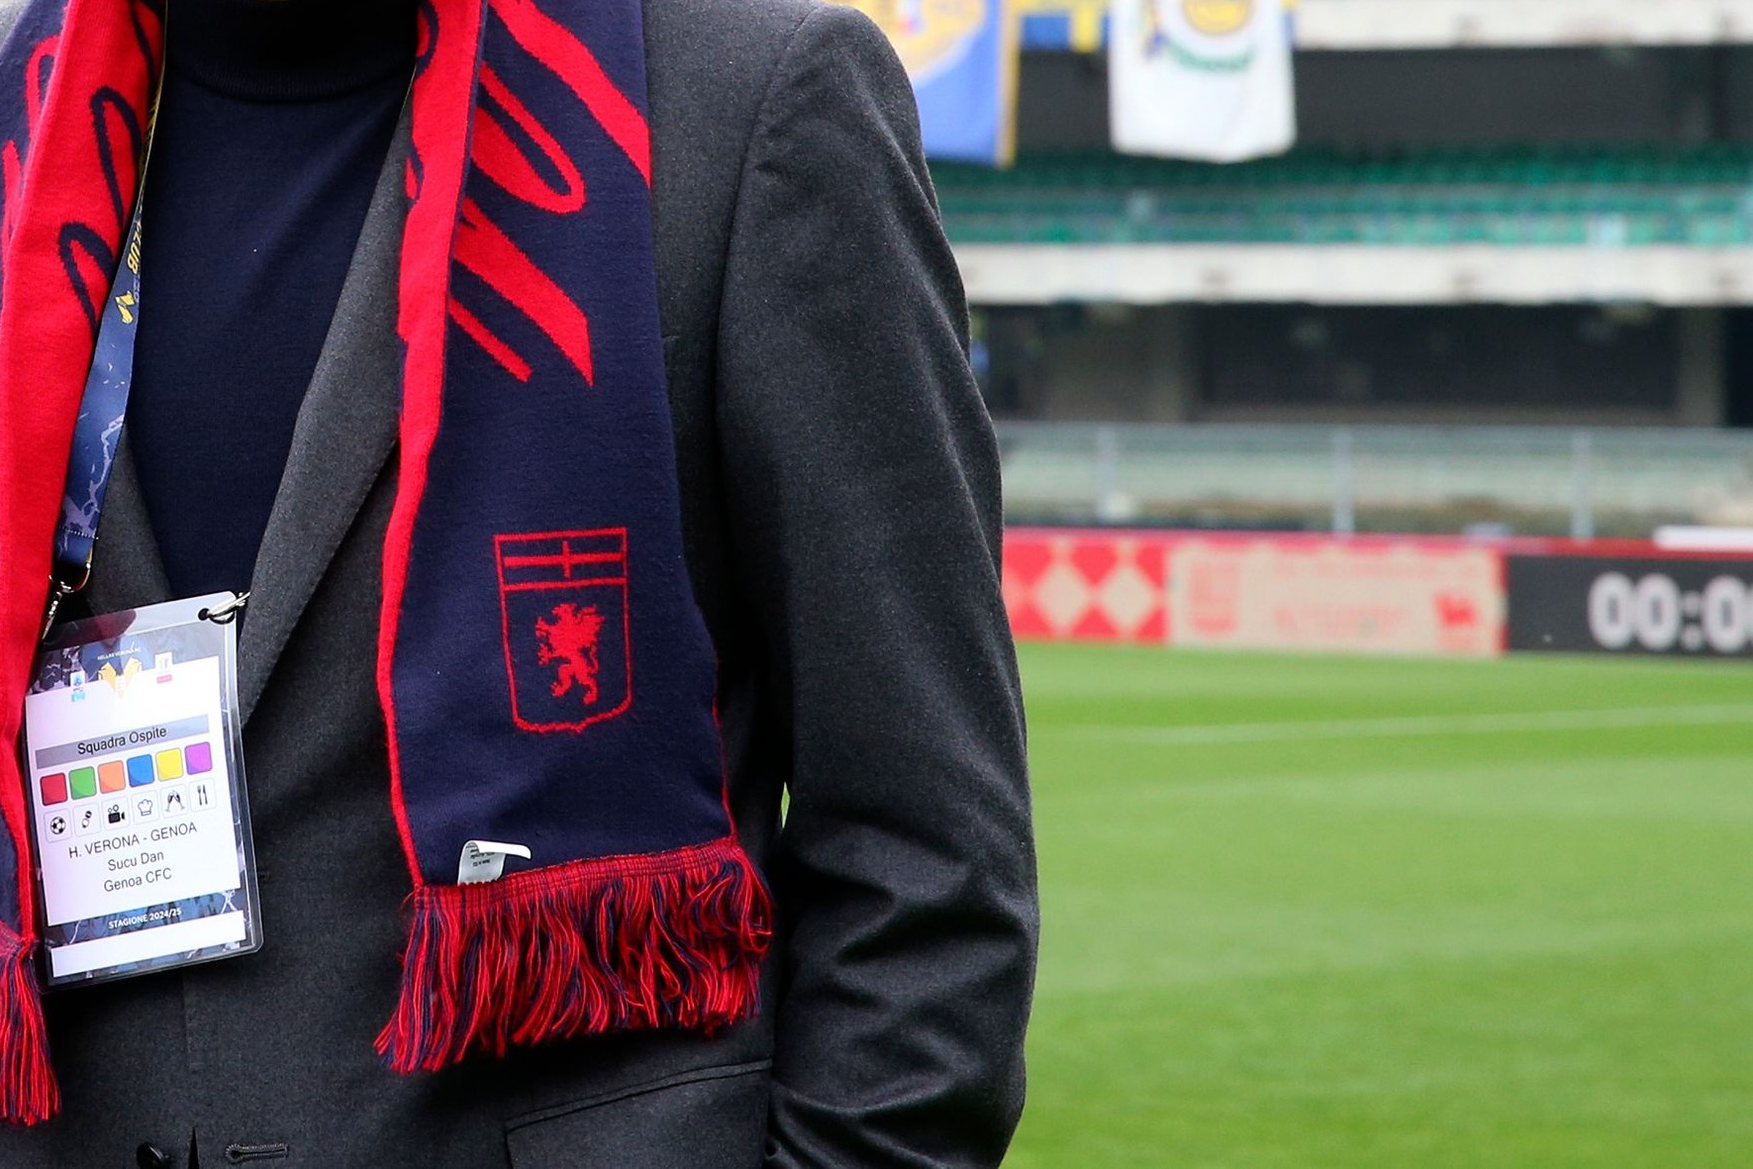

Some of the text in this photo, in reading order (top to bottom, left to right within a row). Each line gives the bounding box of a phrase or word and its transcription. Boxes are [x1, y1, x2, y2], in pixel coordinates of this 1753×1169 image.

[1586, 569, 1753, 654] 00:0
[77, 725, 167, 756] Squadra Ospite
[69, 846, 82, 859] H.
[84, 834, 140, 855] VERONA
[150, 822, 198, 842] GENOA
[107, 851, 165, 872] Sucu Dan
[103, 867, 173, 892] Genoa CFC
[108, 907, 183, 930] STAGIONE 2024/25
